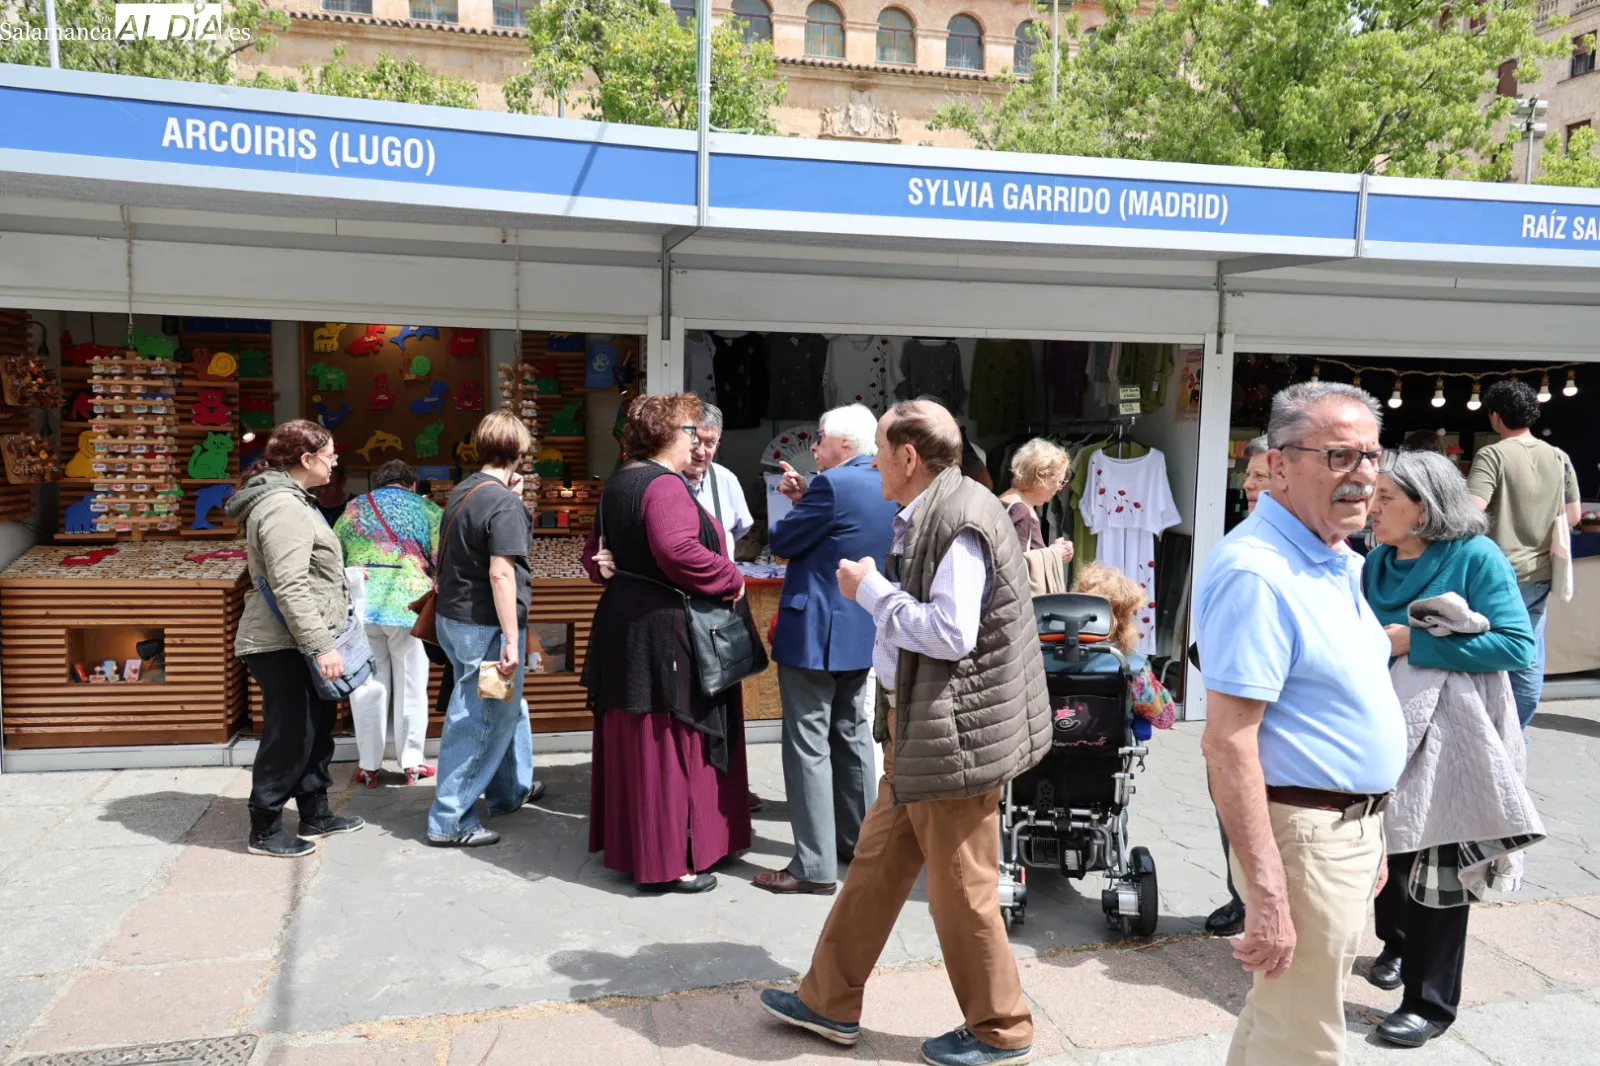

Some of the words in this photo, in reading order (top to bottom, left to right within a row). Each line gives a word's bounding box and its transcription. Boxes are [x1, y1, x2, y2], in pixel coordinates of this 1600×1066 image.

[162, 117, 317, 160] ARCOIRIS
[329, 131, 436, 176] (LUGO)
[908, 177, 995, 208] SYLVIA
[1002, 182, 1111, 215] GARRIDO
[1119, 189, 1229, 226] (MADRID)
[1521, 210, 1568, 240] RAÍZ
[1572, 216, 1600, 241] SA
